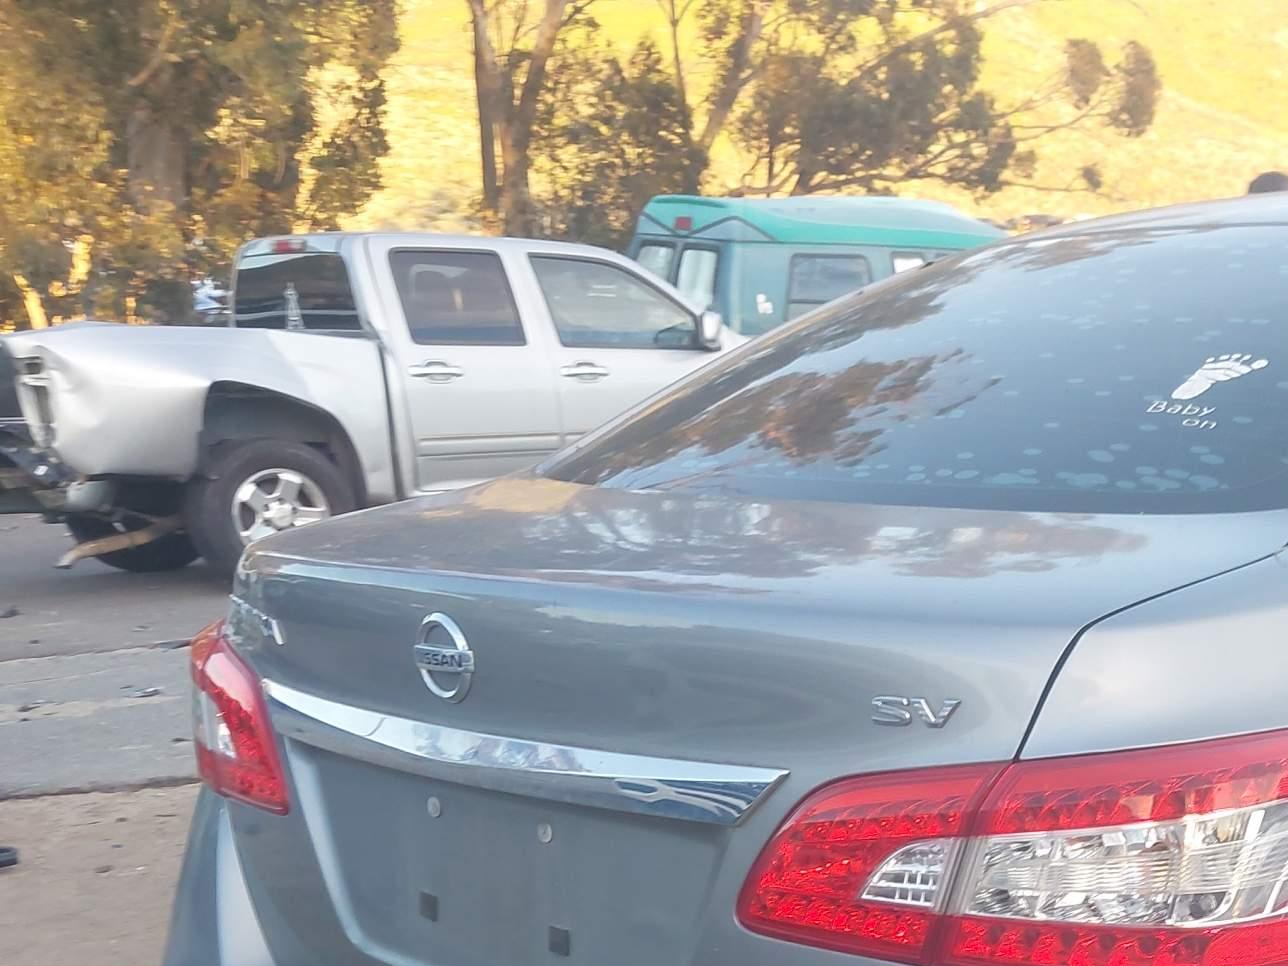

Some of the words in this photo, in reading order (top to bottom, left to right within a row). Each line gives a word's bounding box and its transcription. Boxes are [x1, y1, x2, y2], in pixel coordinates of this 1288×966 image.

[1145, 400, 1217, 417] Baby
[1182, 418, 1217, 429] on
[420, 650, 463, 668] SSAN
[871, 695, 961, 728] SV
